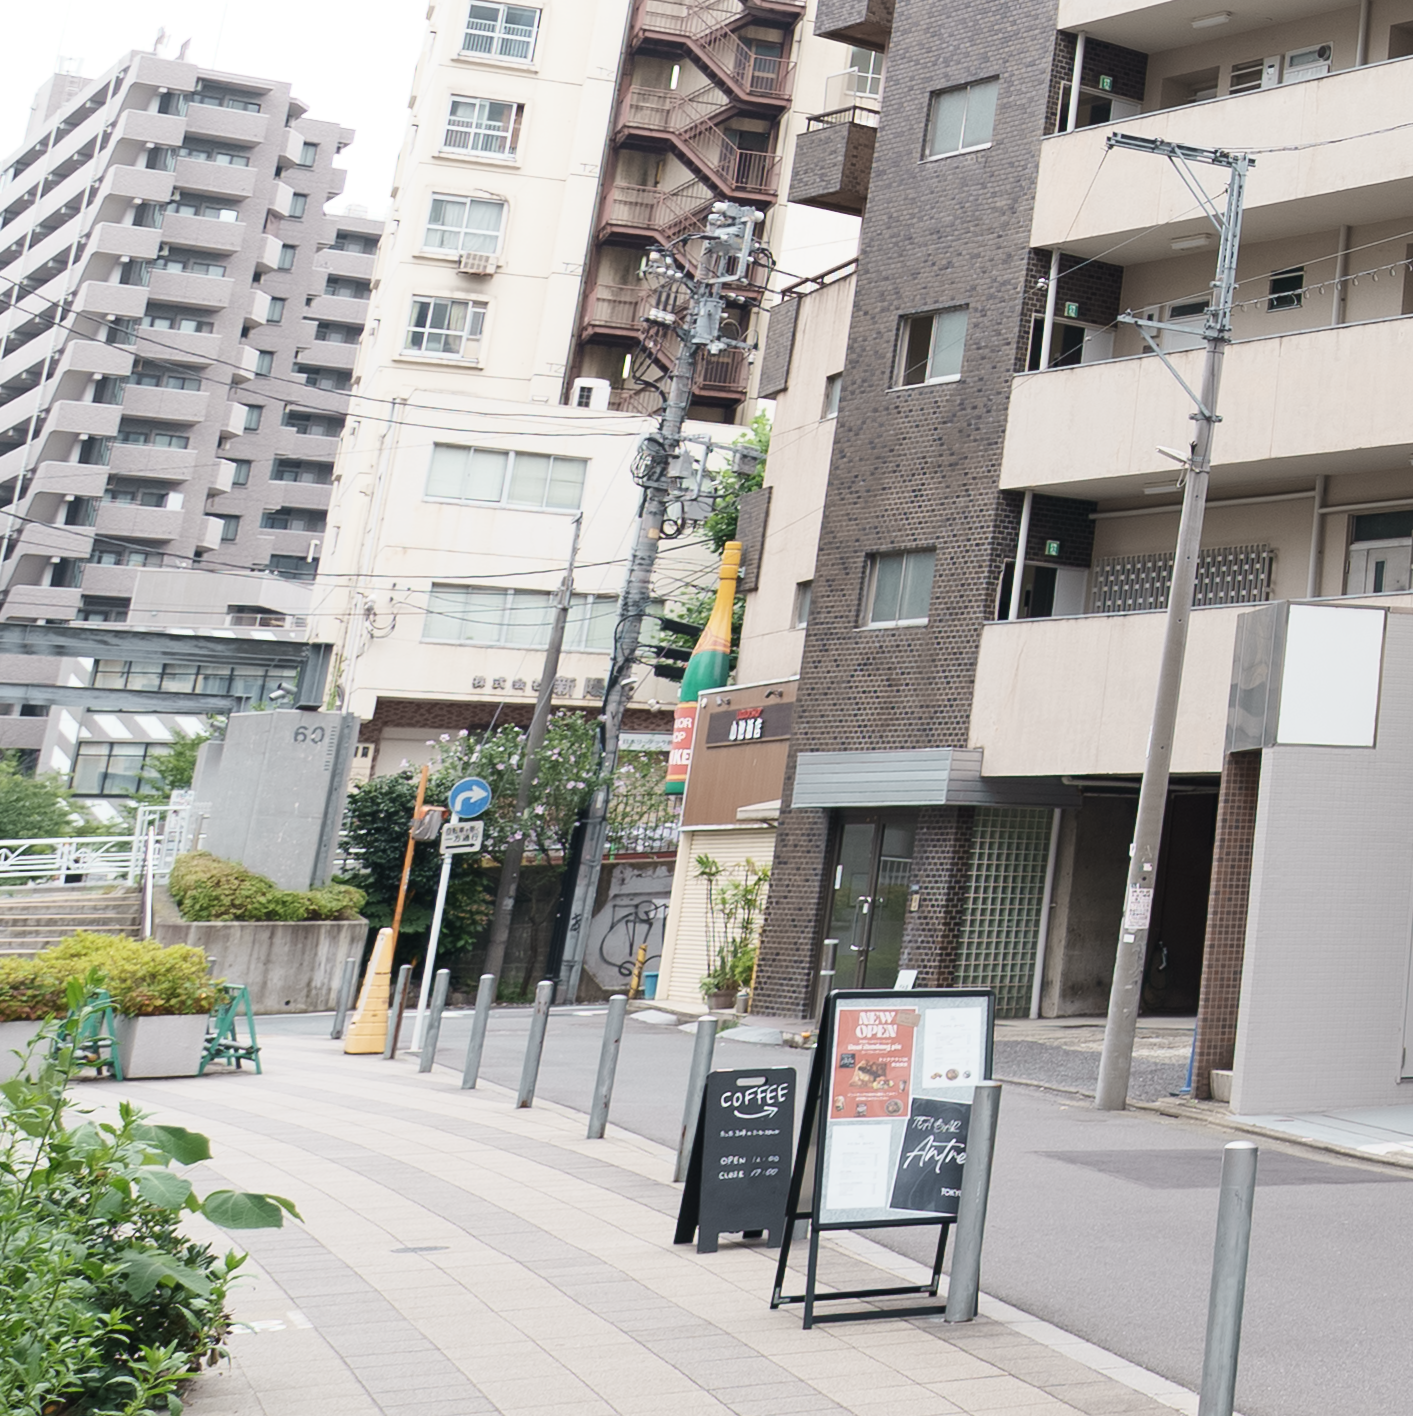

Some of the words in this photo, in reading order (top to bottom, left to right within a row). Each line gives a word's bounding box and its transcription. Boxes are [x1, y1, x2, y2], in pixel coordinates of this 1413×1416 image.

[294, 725, 325, 745] 60
[445, 834, 479, 843] 一方通行
[859, 1011, 895, 1025] NEW
[855, 1025, 897, 1038] OPEN
[721, 1083, 788, 1107] COFFEE
[912, 1116, 934, 1130] TEA
[933, 1120, 962, 1133] BAR
[720, 1155, 746, 1165] OPEN
[902, 1135, 967, 1174] Antre
[718, 1170, 745, 1180] CLOSE
